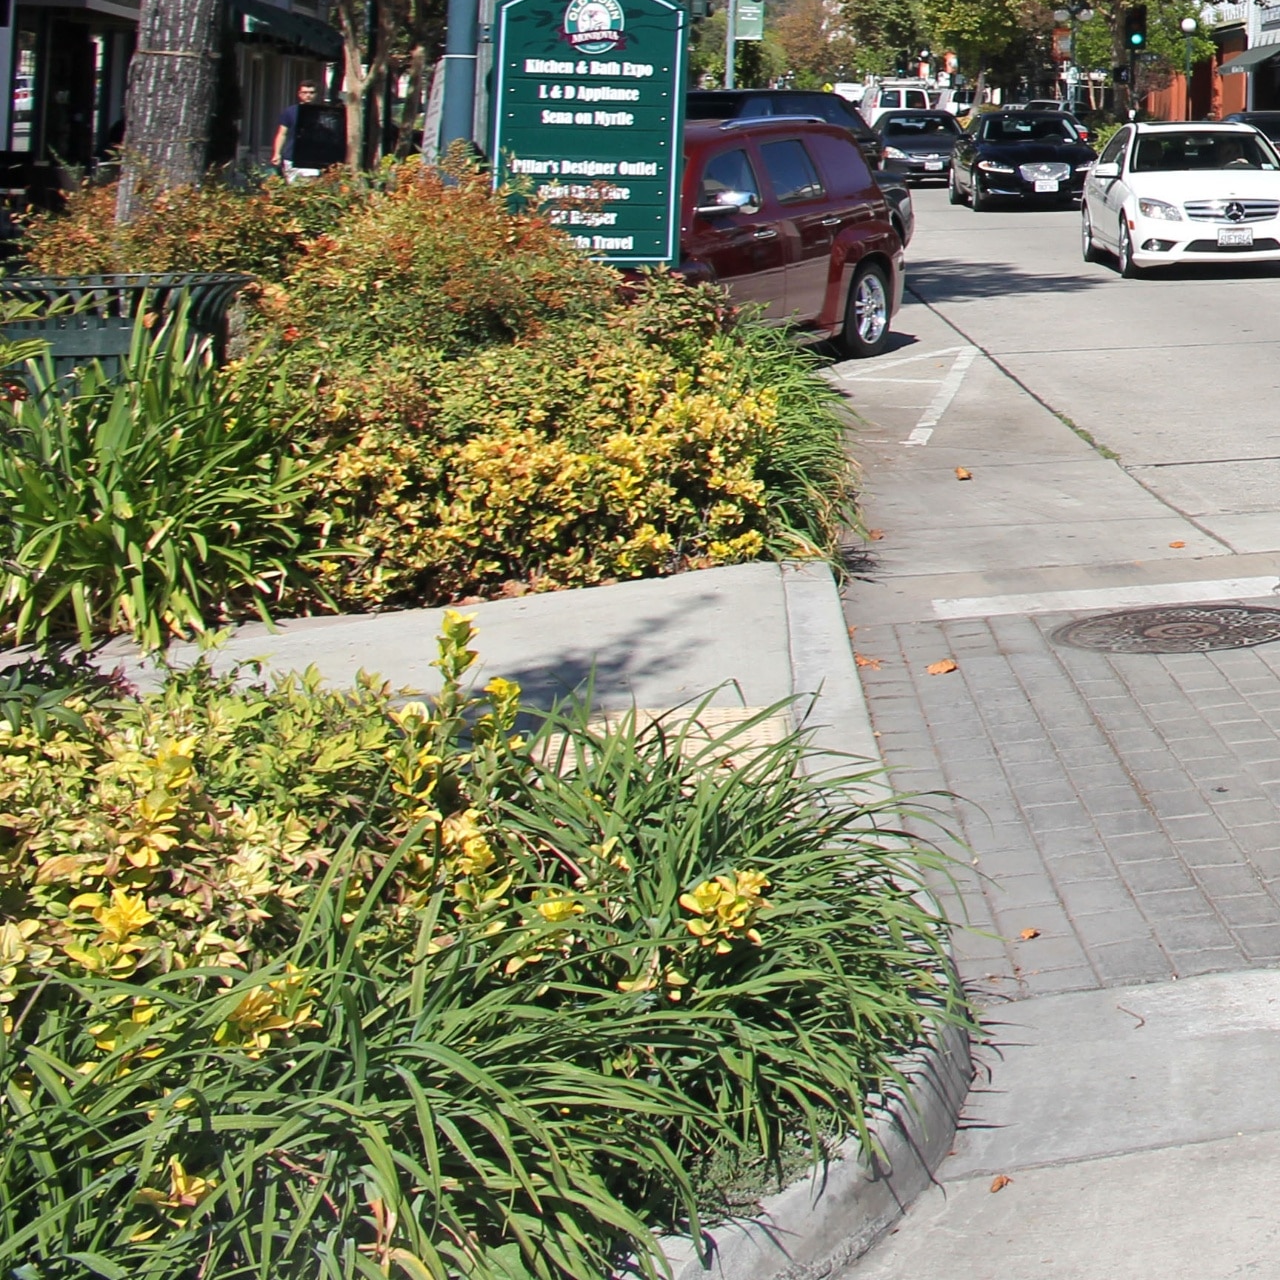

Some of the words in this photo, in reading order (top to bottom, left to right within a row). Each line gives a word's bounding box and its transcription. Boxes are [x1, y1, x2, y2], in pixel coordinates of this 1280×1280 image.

[525, 59, 575, 75] Kitchen
[576, 60, 588, 75] &
[590, 60, 620, 76] Bath
[622, 62, 654, 78] Expo
[538, 84, 548, 99] L
[550, 85, 562, 99] &
[564, 86, 575, 99] D
[577, 86, 640, 102] Appliance
[541, 109, 573, 125] Sena
[575, 112, 589, 125] on
[594, 111, 634, 127] Myrtle
[511, 159, 558, 174] Pillar's
[561, 160, 616, 176] Designer
[619, 161, 658, 176] Outlet
[592, 235, 634, 250] Travel
